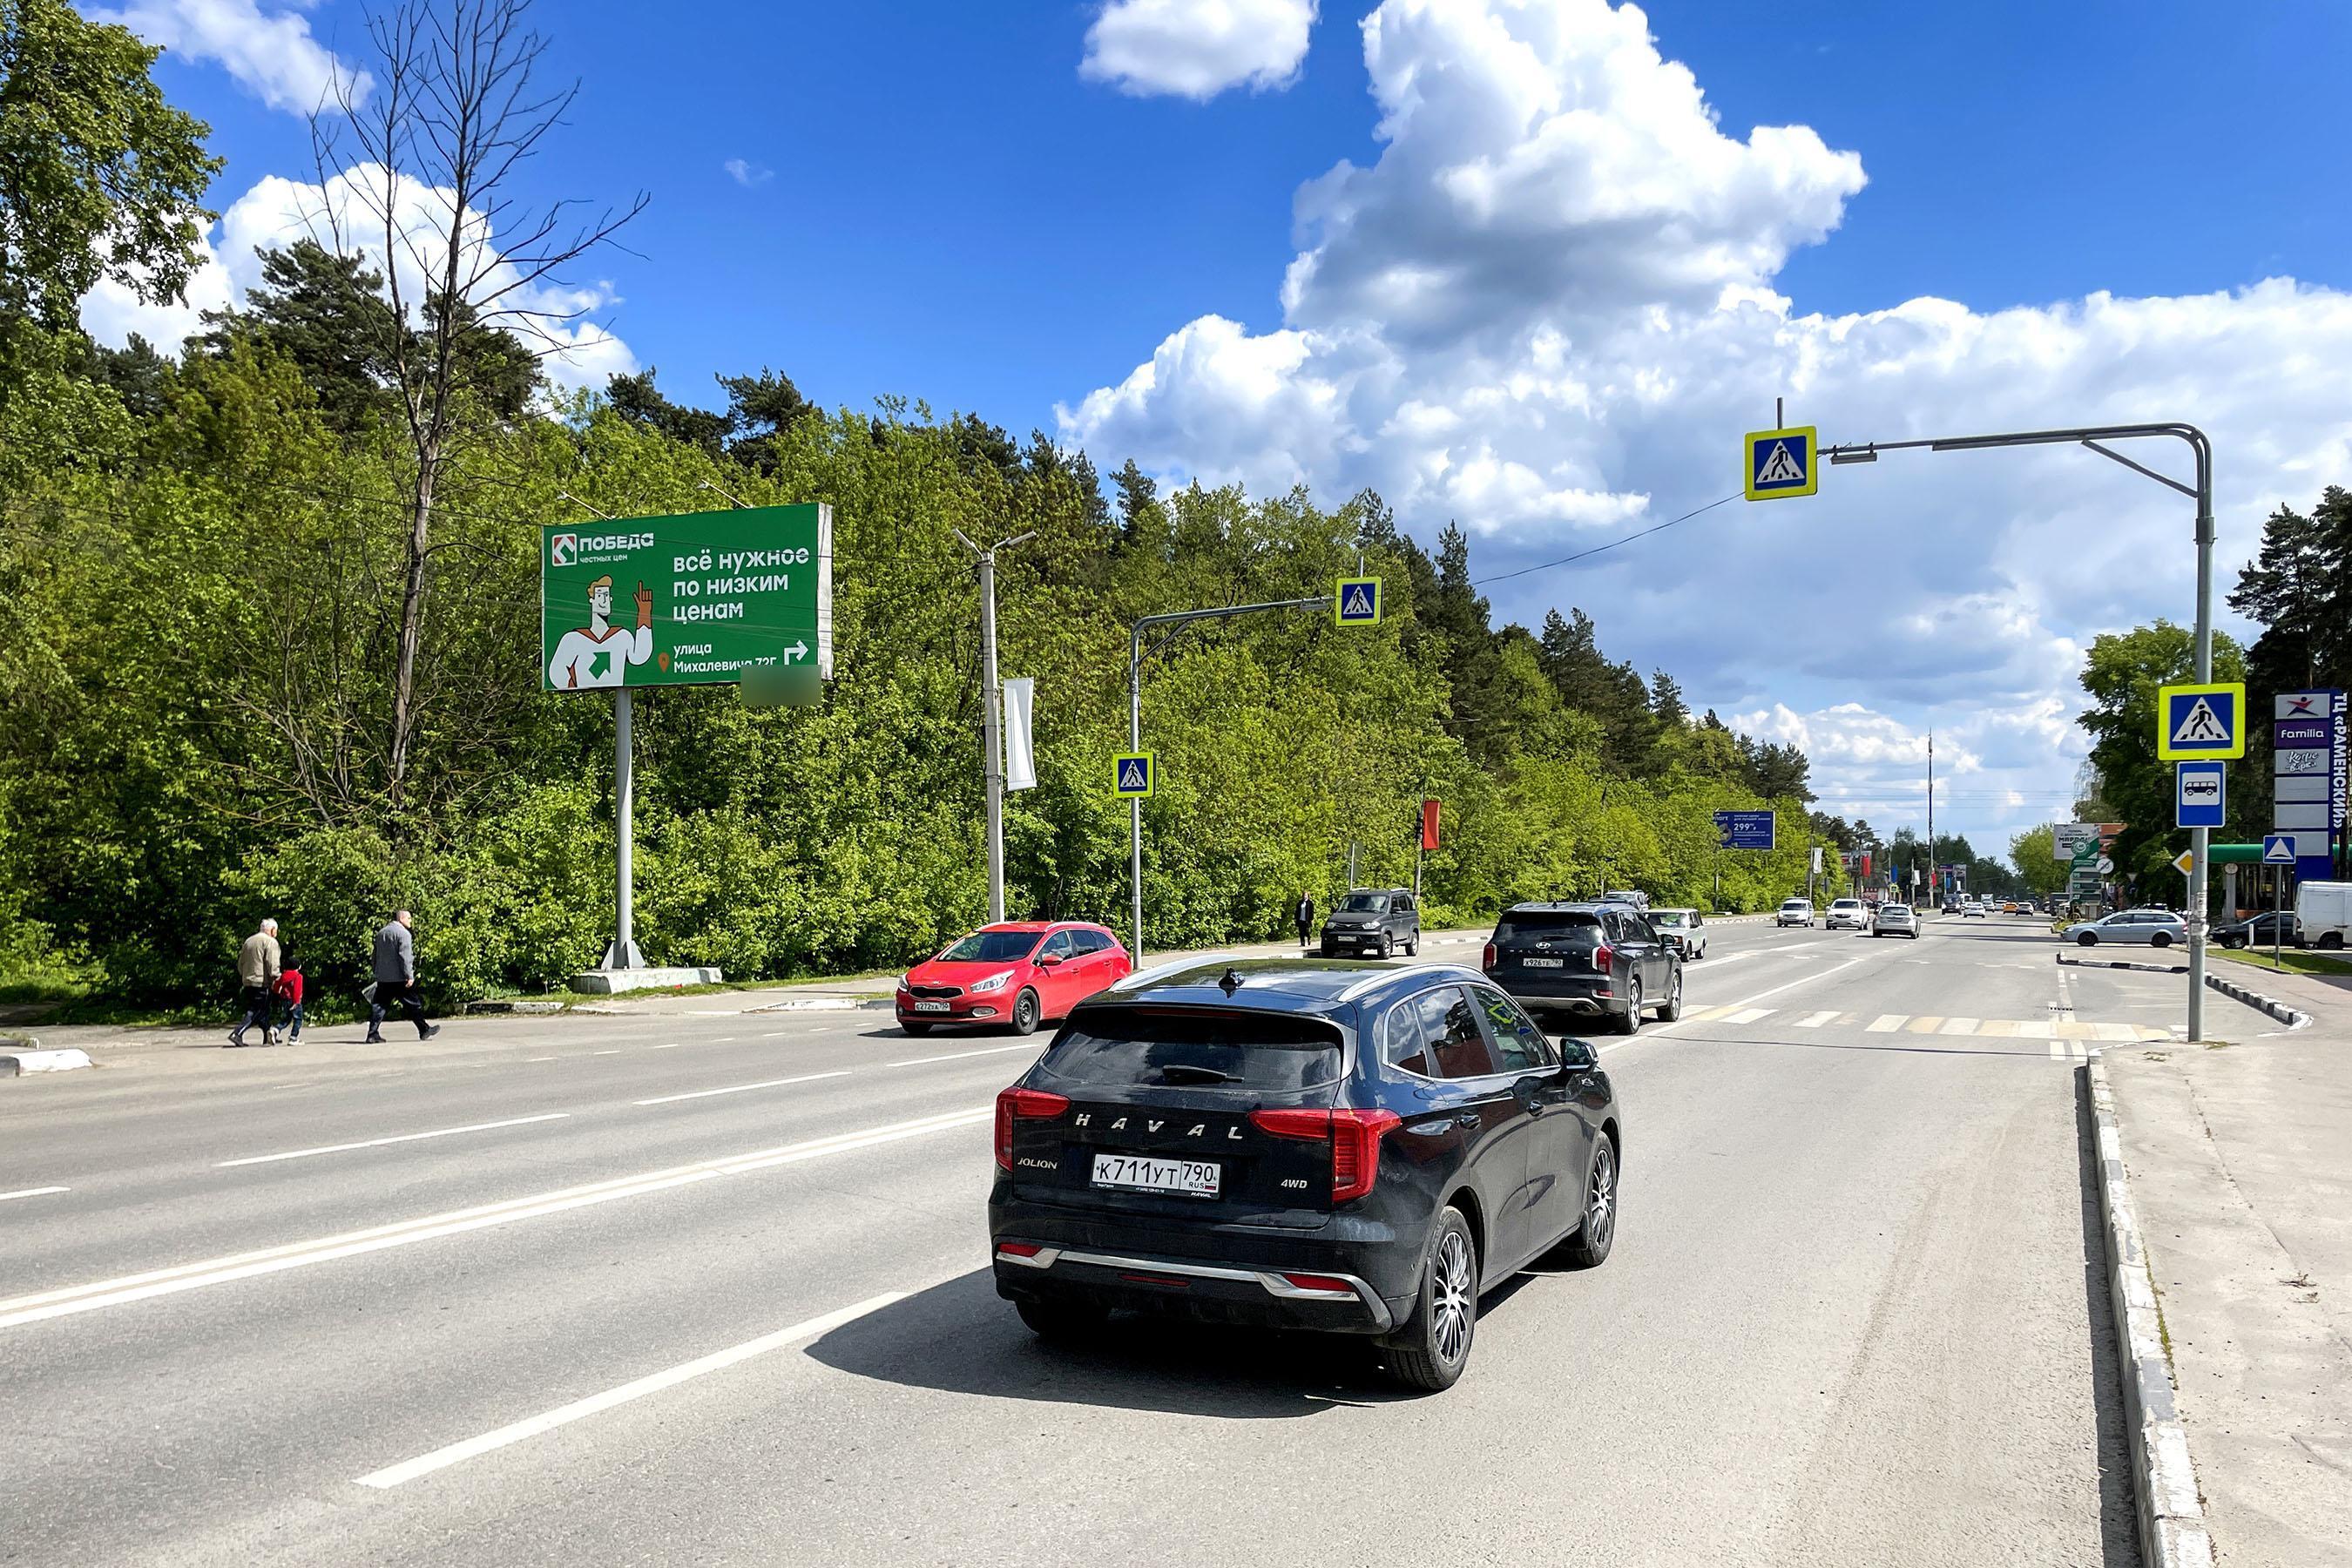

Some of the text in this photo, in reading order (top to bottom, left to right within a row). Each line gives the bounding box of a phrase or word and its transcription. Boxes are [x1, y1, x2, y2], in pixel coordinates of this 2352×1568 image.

[579, 554, 628, 564] честных цен
[673, 547, 809, 575] всё нужное
[673, 574, 788, 598] по низким
[672, 602, 744, 625] ценам
[673, 644, 713, 659] улица
[2332, 692, 2349, 713] ТЦ
[1734, 822, 1750, 831] 299
[1075, 1113, 1243, 1140] HAVAL
[1017, 1157, 1058, 1170] JOLION
[1099, 1159, 1214, 1186] К711УТ 790
[1280, 1179, 1308, 1189] 4WD
